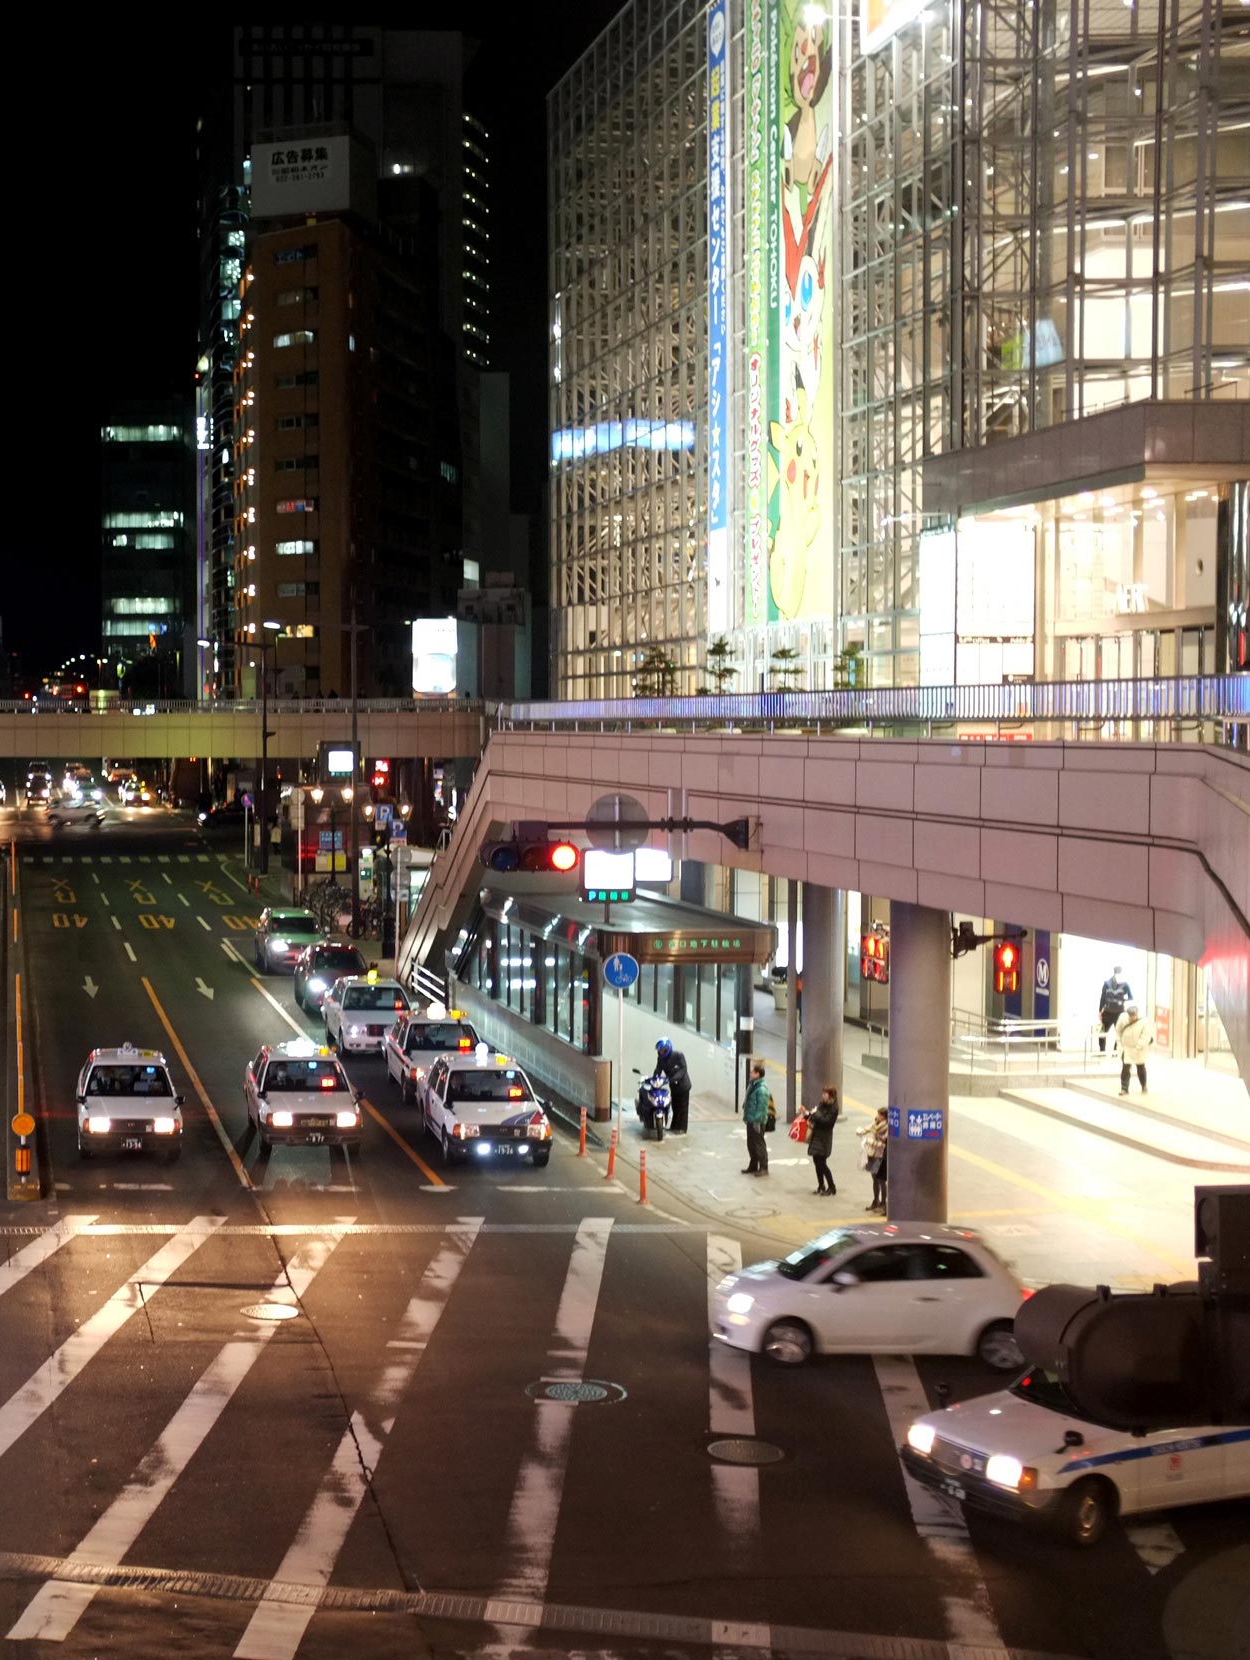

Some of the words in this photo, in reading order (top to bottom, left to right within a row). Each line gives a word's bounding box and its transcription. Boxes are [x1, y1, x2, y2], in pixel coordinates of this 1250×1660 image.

[770, 8, 778, 119] Pokémon
[271, 147, 328, 165] 広告募集
[770, 124, 778, 203] Center
[769, 209, 778, 309] TOHOKU
[52, 913, 88, 929] 40
[137, 913, 175, 930] 40
